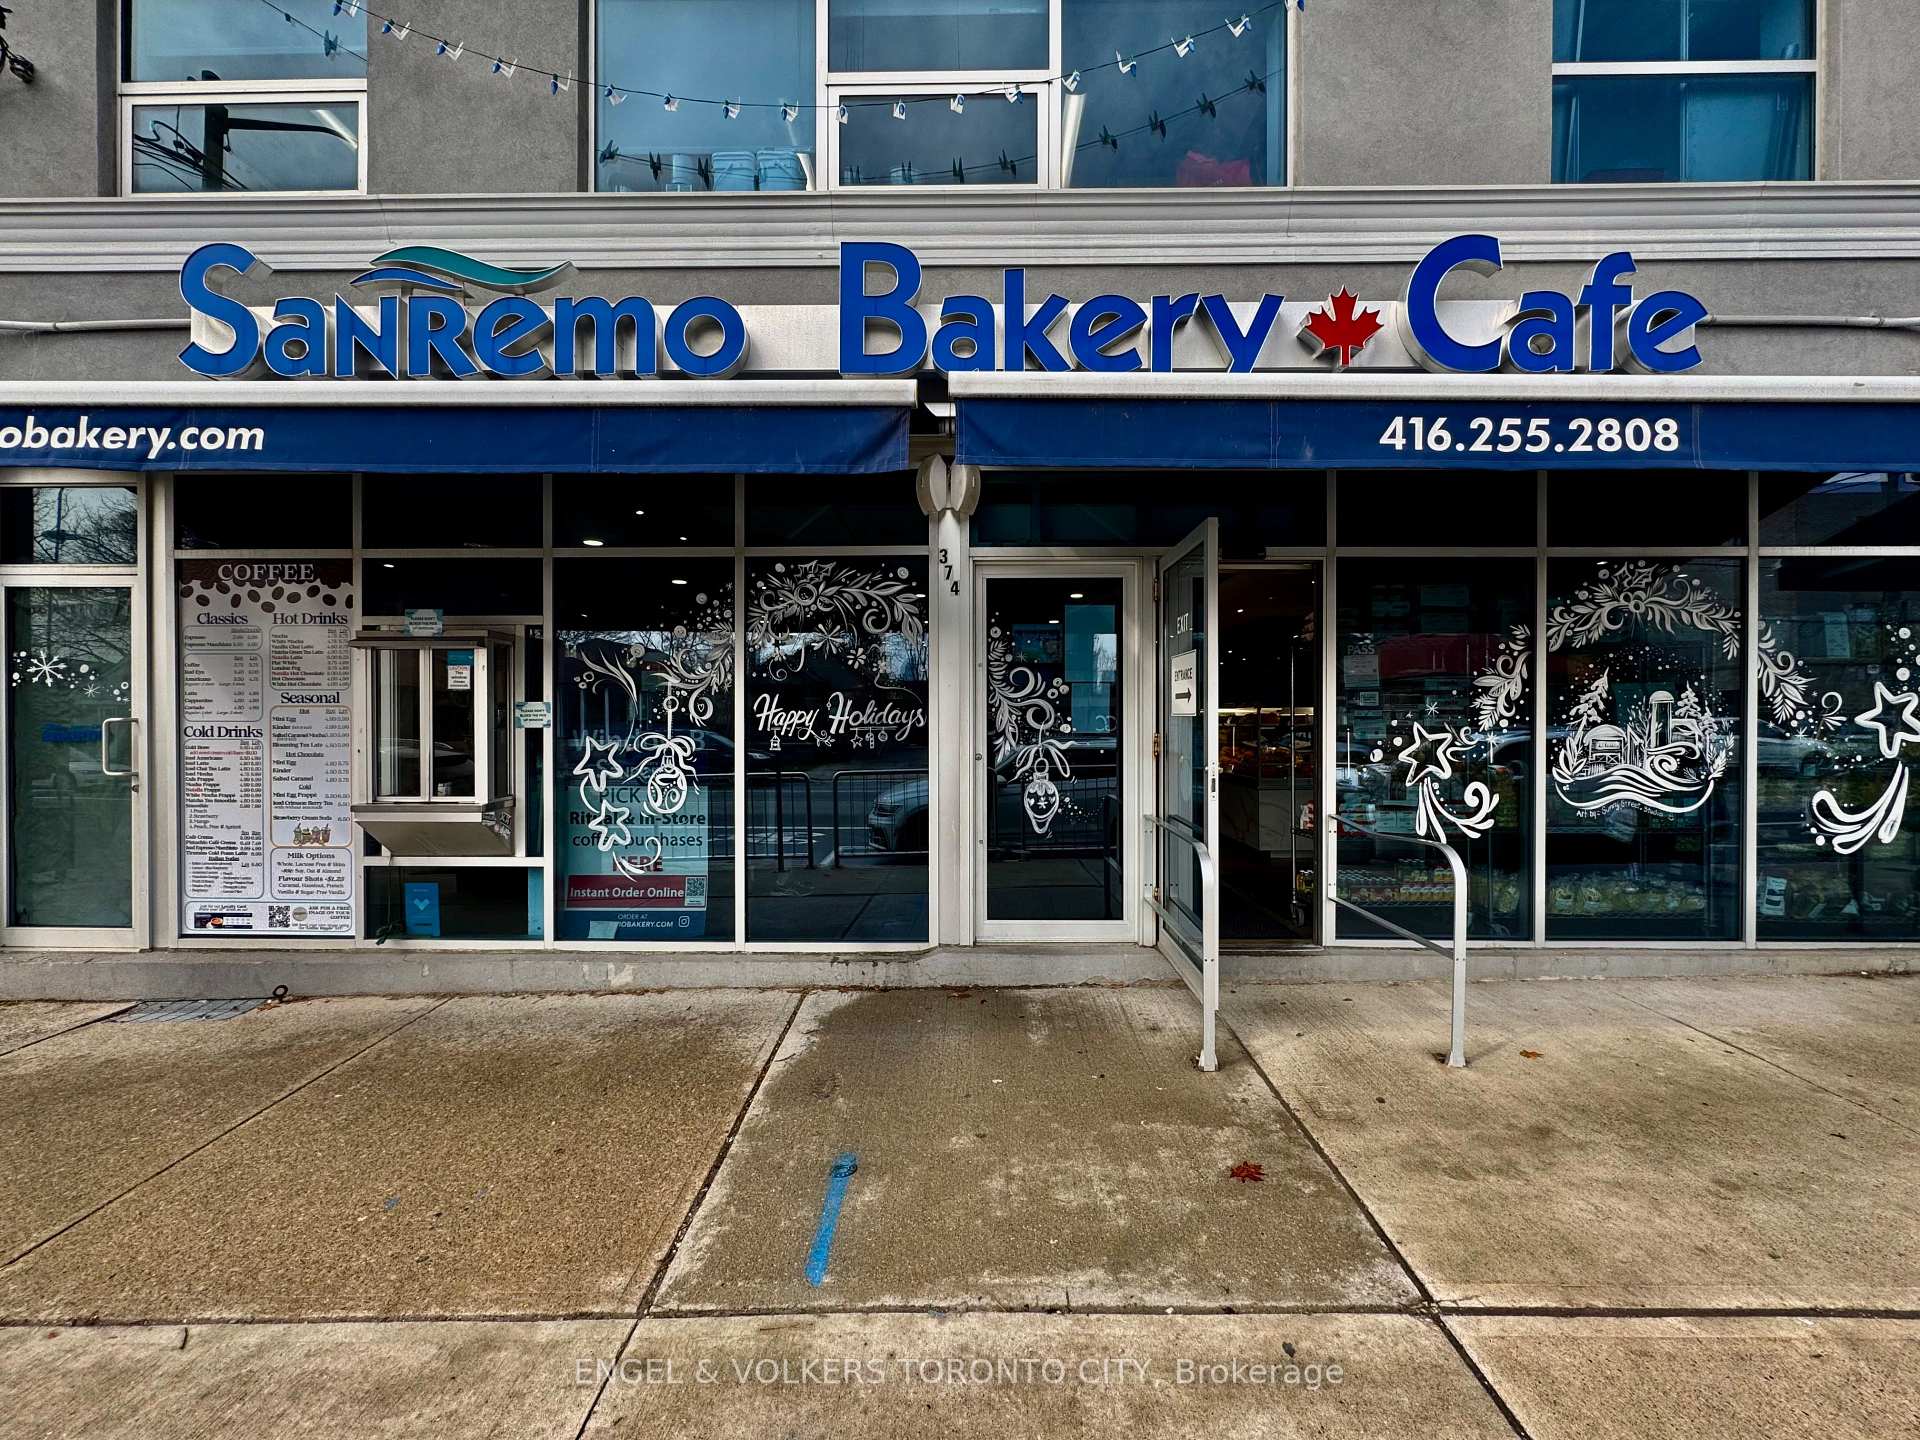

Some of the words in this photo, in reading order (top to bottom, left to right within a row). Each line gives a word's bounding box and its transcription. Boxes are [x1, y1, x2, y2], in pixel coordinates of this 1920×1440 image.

[839, 241, 1286, 375] Bakery
[1405, 234, 1709, 373] Cafe
[1379, 416, 1679, 453] 416.255.2808
[218, 564, 314, 580] COFFEE
[197, 612, 248, 625] Classics
[273, 613, 302, 625] Hot
[302, 612, 348, 625] Drinks
[1177, 613, 1189, 634] EXIT
[1346, 644, 1376, 656] PASS
[1174, 668, 1193, 682] ENTRANCE
[281, 692, 340, 704] Seasonal
[753, 693, 820, 741] Happy
[826, 691, 927, 742] Holidays
[184, 725, 214, 738] Cold
[218, 725, 263, 738] Drinks
[599, 787, 641, 804] PICK
[639, 812, 706, 825] In-Store
[1576, 809, 1588, 819] Art
[624, 832, 703, 849] puhases
[305, 852, 336, 861] Options
[570, 887, 609, 898] Instant
[612, 887, 645, 898] Order
[647, 886, 684, 898] Online
